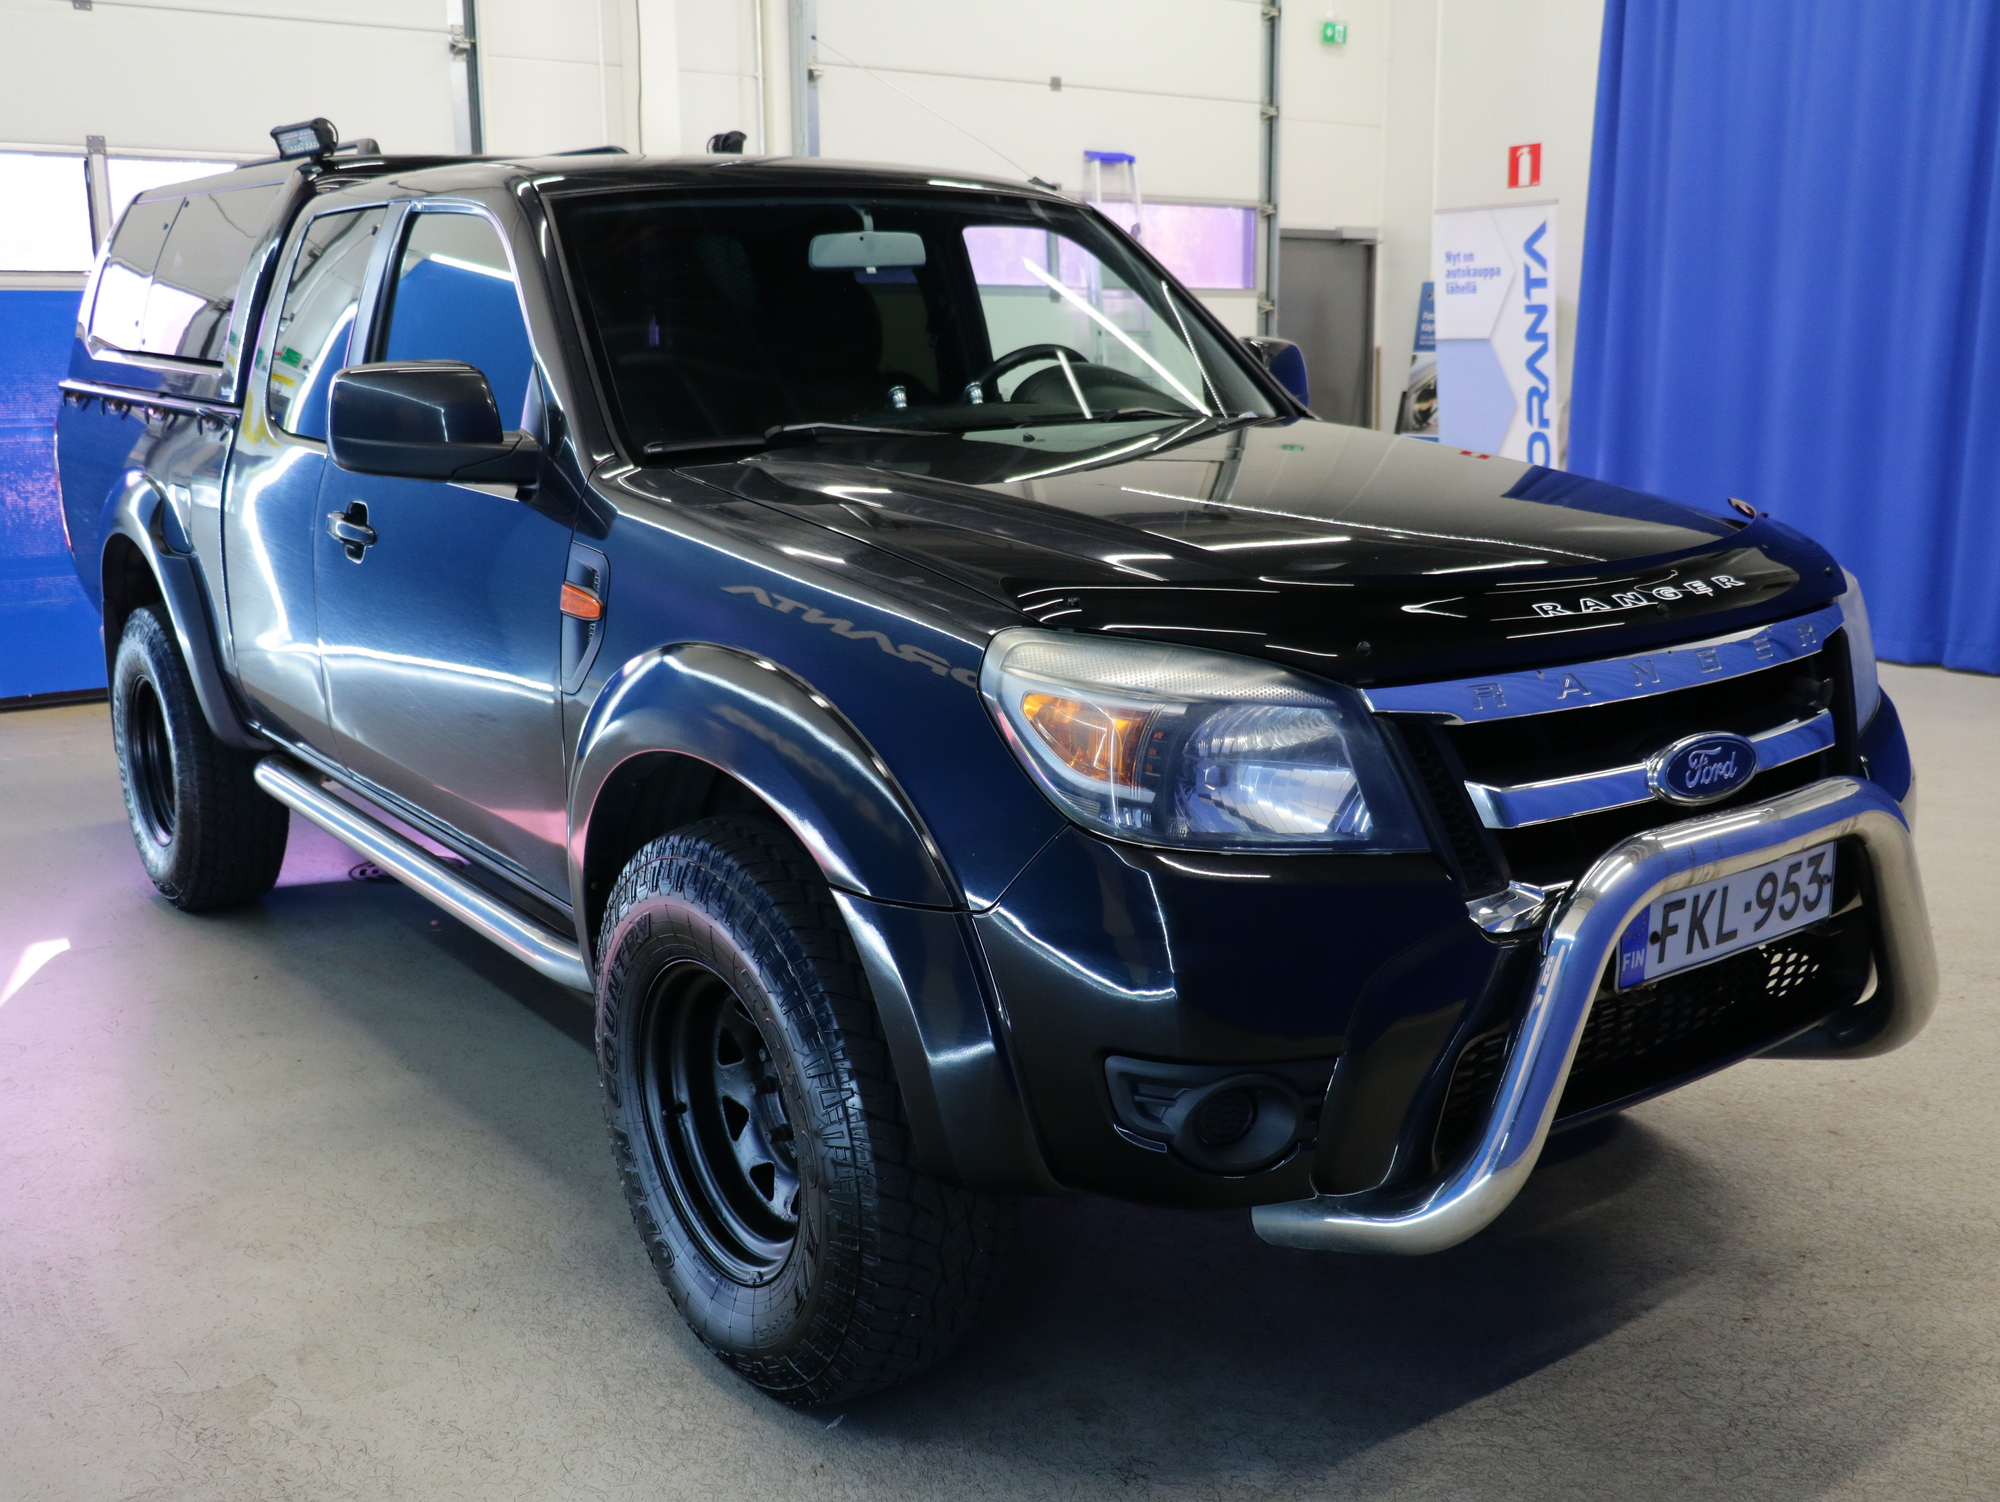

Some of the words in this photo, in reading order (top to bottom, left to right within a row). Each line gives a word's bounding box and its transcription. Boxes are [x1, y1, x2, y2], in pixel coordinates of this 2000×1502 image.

[1445, 251, 1460, 266] Nyt
[1463, 253, 1475, 263] on
[1445, 266, 1502, 281] autokauppa
[1445, 281, 1477, 295] lähellä
[1532, 575, 1746, 618] RANGER
[1467, 622, 1818, 711] RANGER
[1685, 745, 1739, 789] Ford
[1621, 948, 1646, 972] FIN
[1657, 852, 1826, 964] FKL-953
[604, 911, 652, 1108] COUNTRY
[613, 1125, 676, 1270] OPEN
